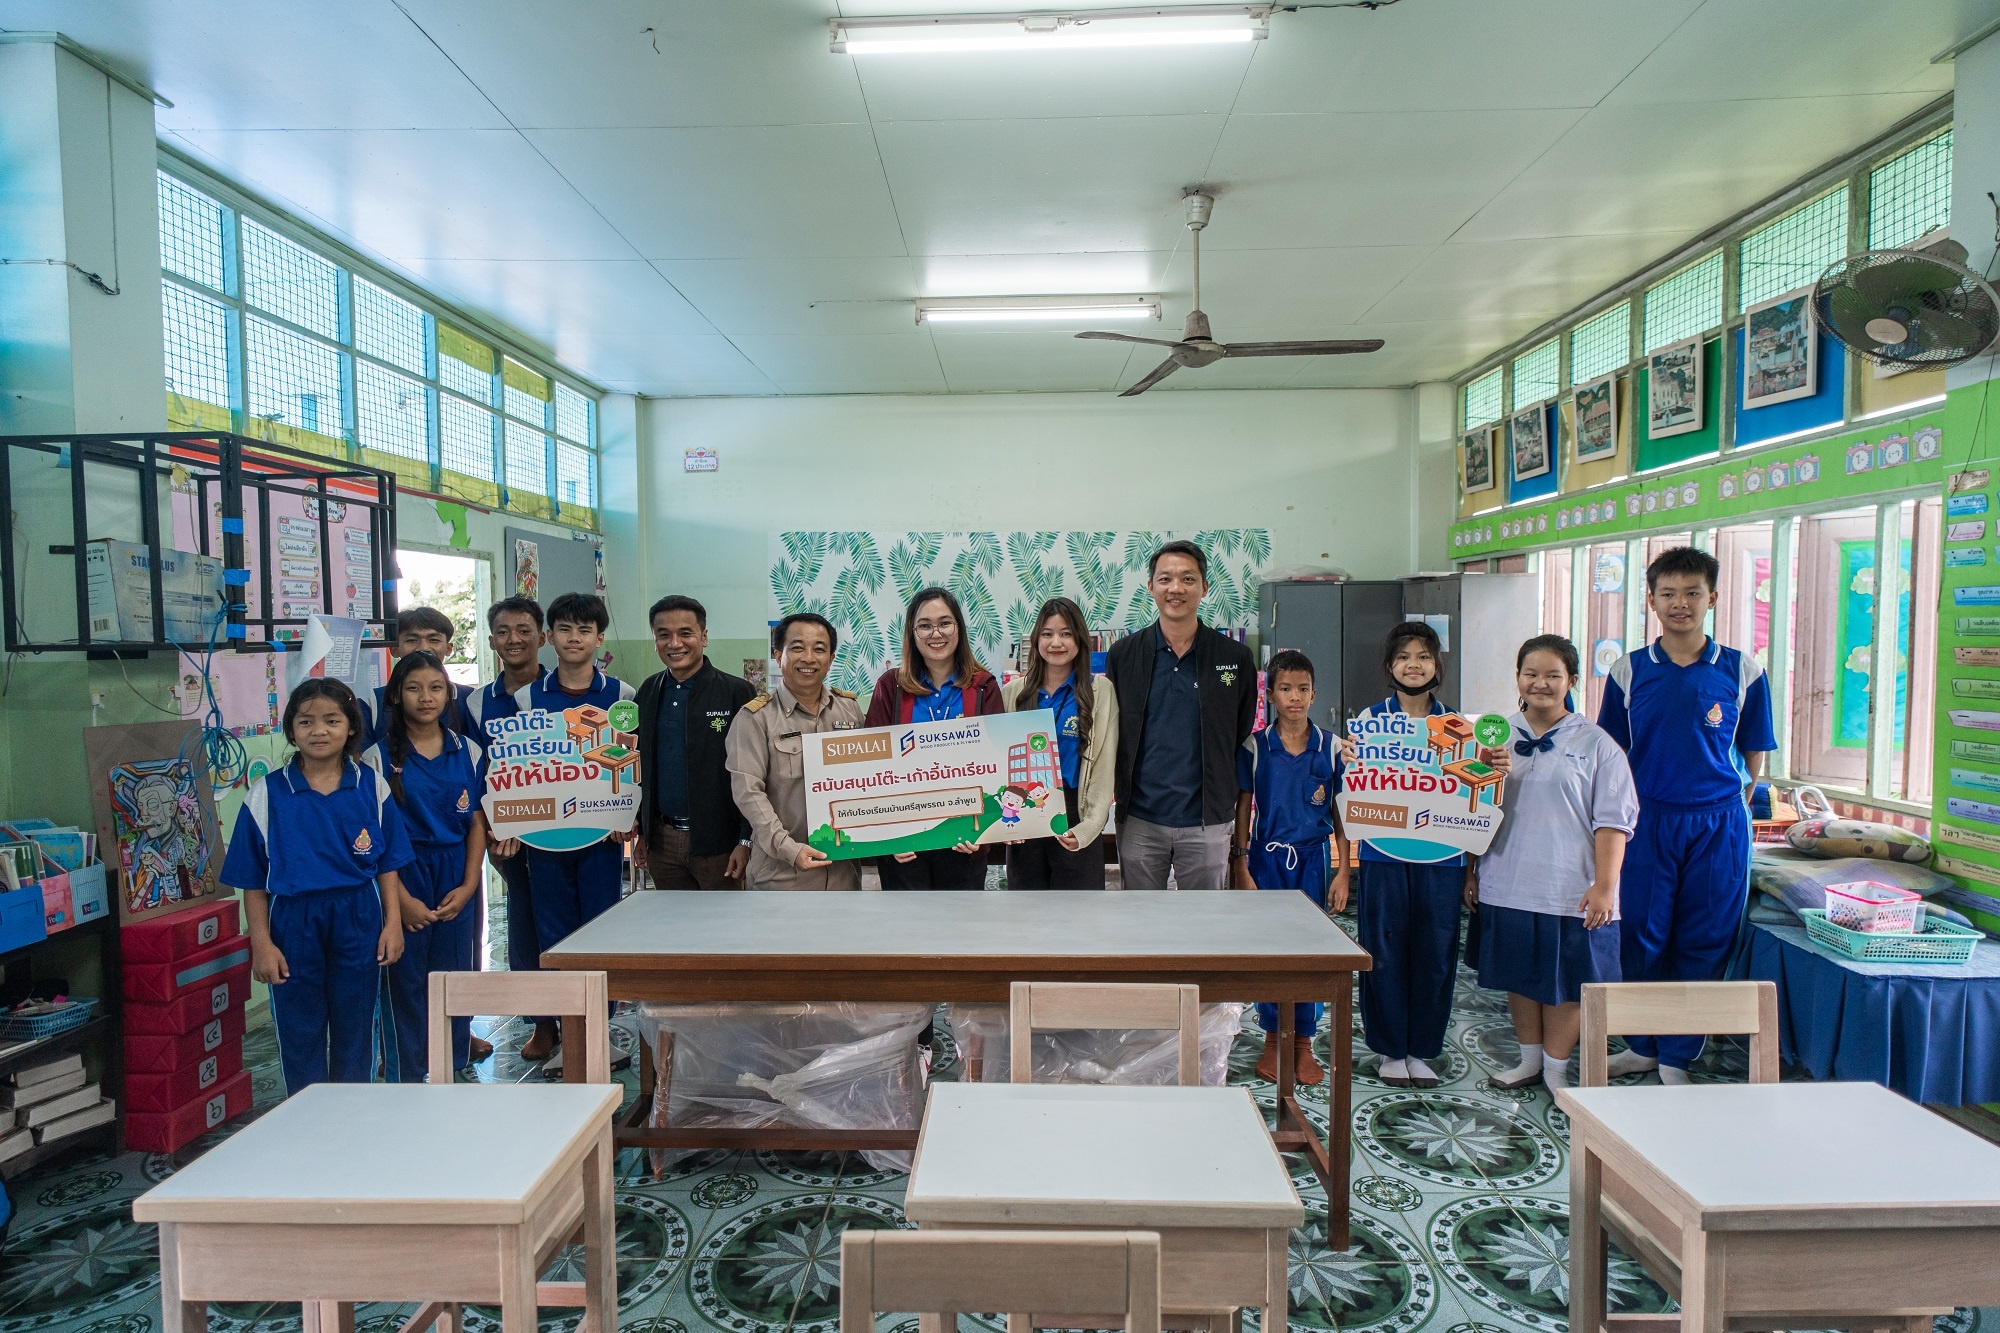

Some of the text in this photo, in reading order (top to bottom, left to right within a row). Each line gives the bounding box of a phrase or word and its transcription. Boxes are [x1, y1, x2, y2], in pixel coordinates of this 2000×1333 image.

[488, 711, 554, 739] ชุดโต๊ะ
[919, 728, 981, 744] SUKSAWAD
[1350, 714, 1415, 740] ชุดโต๊ะ
[491, 737, 572, 759] นักเรียน
[827, 739, 887, 757] SUPALAI
[490, 760, 599, 792] พี่ให้น้อง
[812, 762, 997, 793] สนับสนุนโต๊ะ-เก้าอี้นักเรียน
[1346, 762, 1457, 794] พี่ให้น้อง
[498, 804, 551, 817] SUPALAI
[580, 799, 633, 809] SUKSAWAD
[837, 796, 977, 818] ให้กับโรงเรียนบ้านศรีสุพรรณ จ.ลำพูน
[1350, 806, 1403, 822] SUPALAI
[1433, 815, 1490, 828] SUKSAWAD
